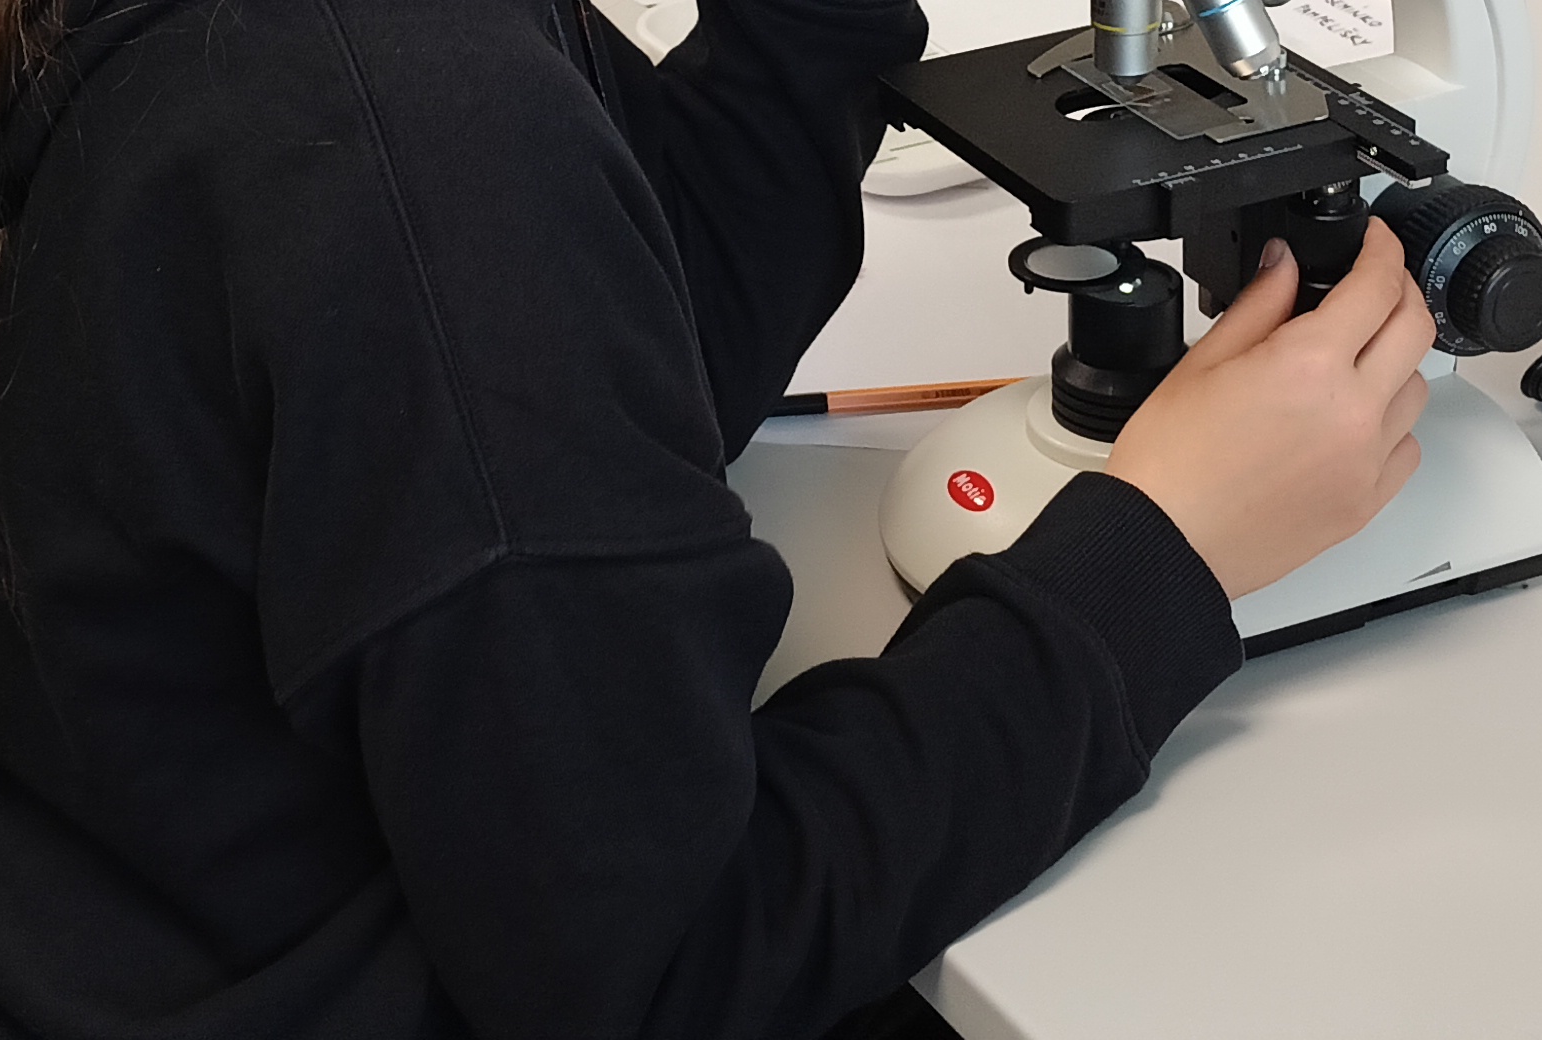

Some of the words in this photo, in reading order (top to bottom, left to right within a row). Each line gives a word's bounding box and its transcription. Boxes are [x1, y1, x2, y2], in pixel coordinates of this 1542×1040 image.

[1483, 222, 1498, 234] 80
[1514, 223, 1528, 237] 100
[1452, 241, 1467, 256] 60
[1434, 275, 1446, 291] 40
[1434, 311, 1446, 325] 20
[952, 473, 987, 506] Motic
